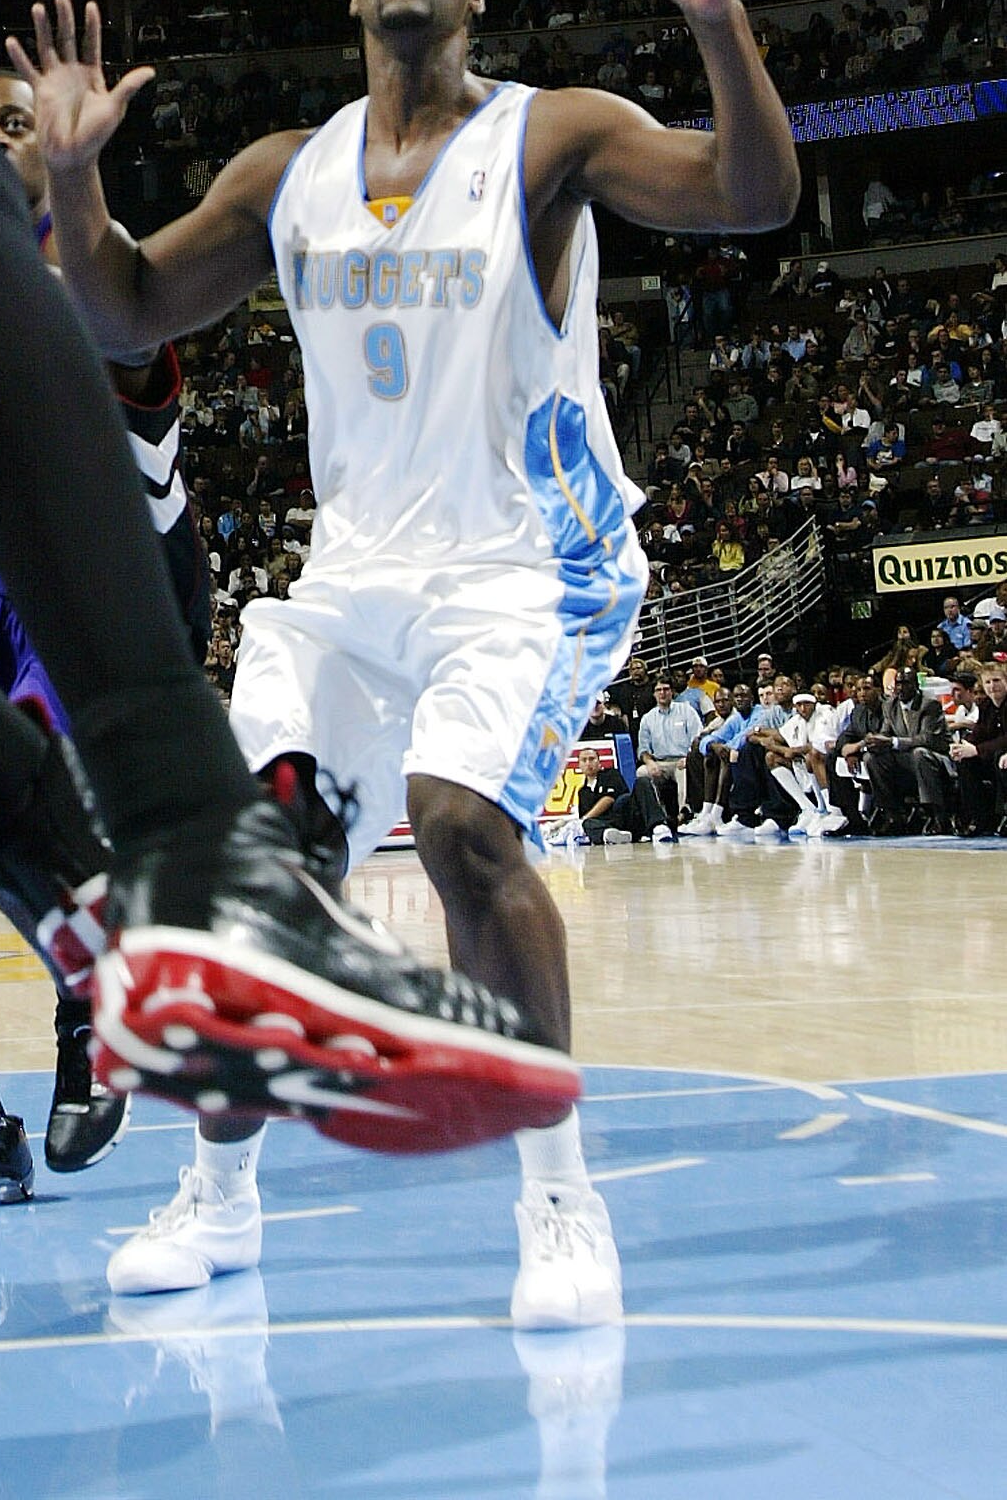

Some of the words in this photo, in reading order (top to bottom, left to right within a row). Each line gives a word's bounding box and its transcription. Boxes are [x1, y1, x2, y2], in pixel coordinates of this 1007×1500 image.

[293, 248, 486, 310] NUGGETS
[365, 320, 409, 402] 9
[878, 551, 1007, 585] Quiznos
